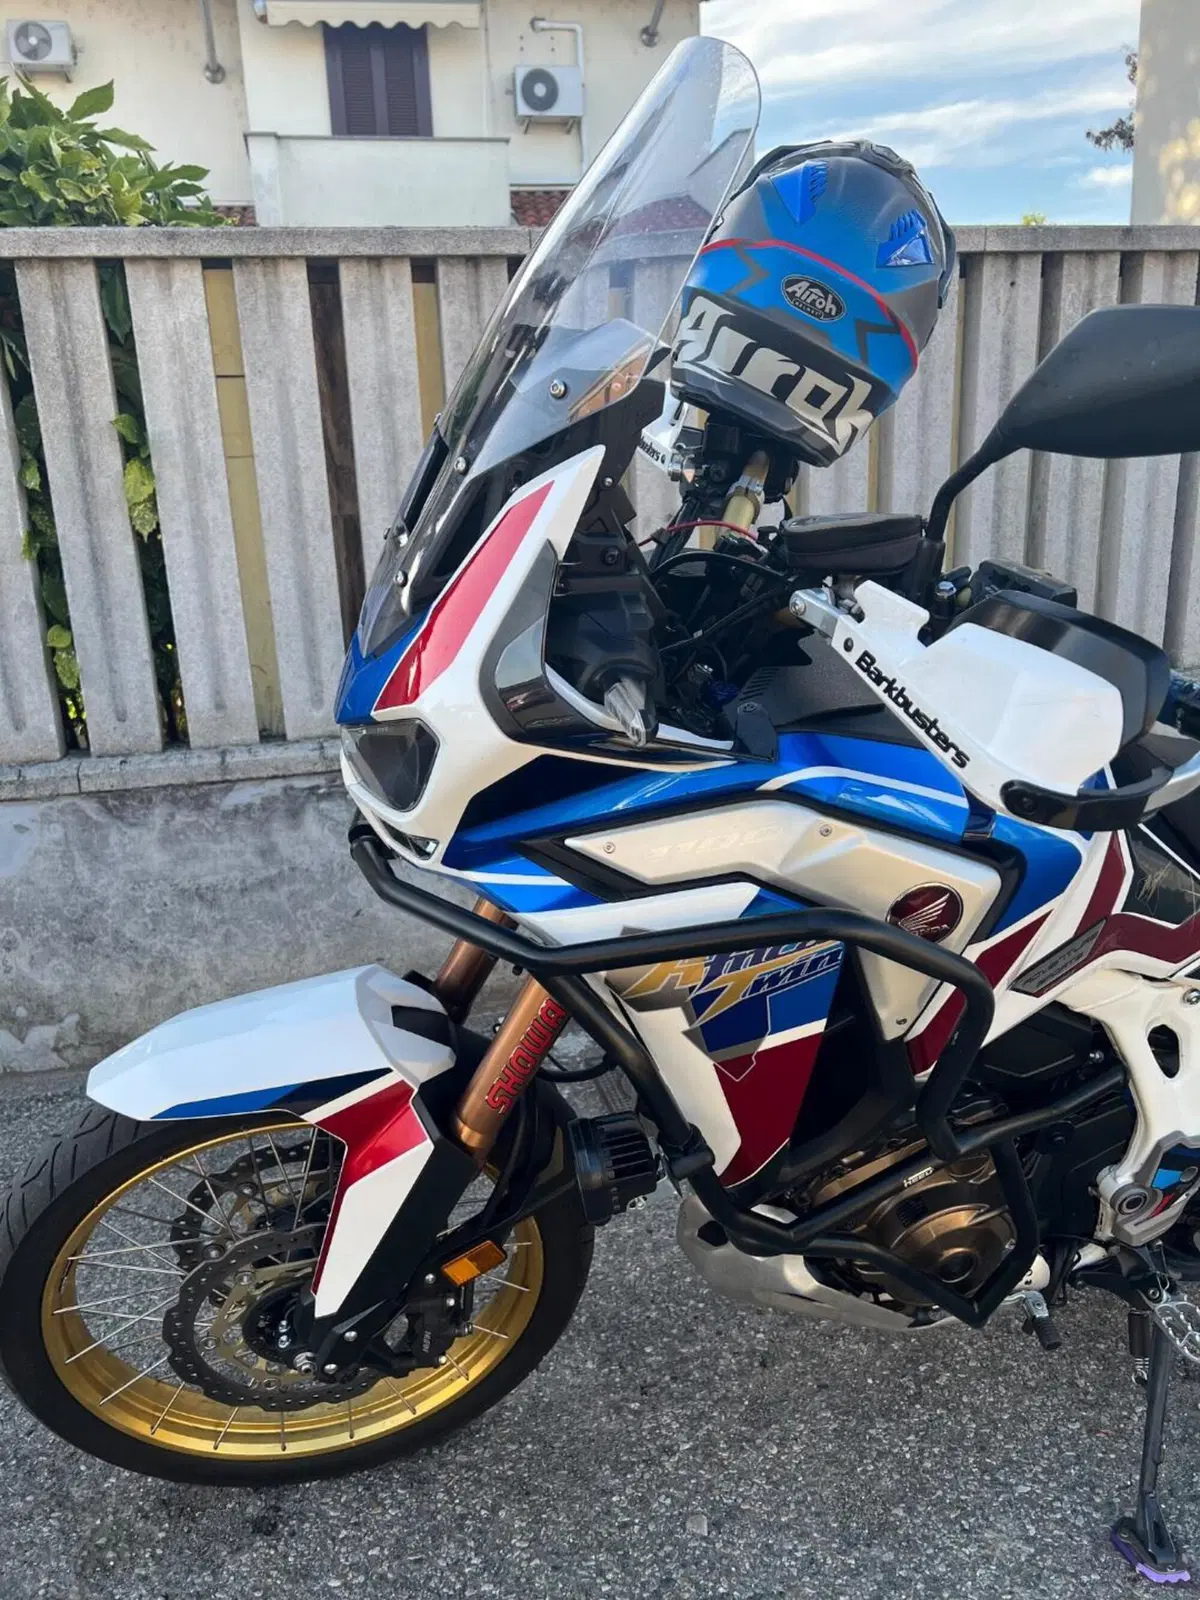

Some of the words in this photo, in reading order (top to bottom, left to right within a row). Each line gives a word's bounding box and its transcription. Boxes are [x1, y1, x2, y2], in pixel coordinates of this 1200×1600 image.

[786, 281, 837, 316] Airoh
[855, 650, 970, 769] Barkbusters
[485, 997, 568, 1115] SHOWA
